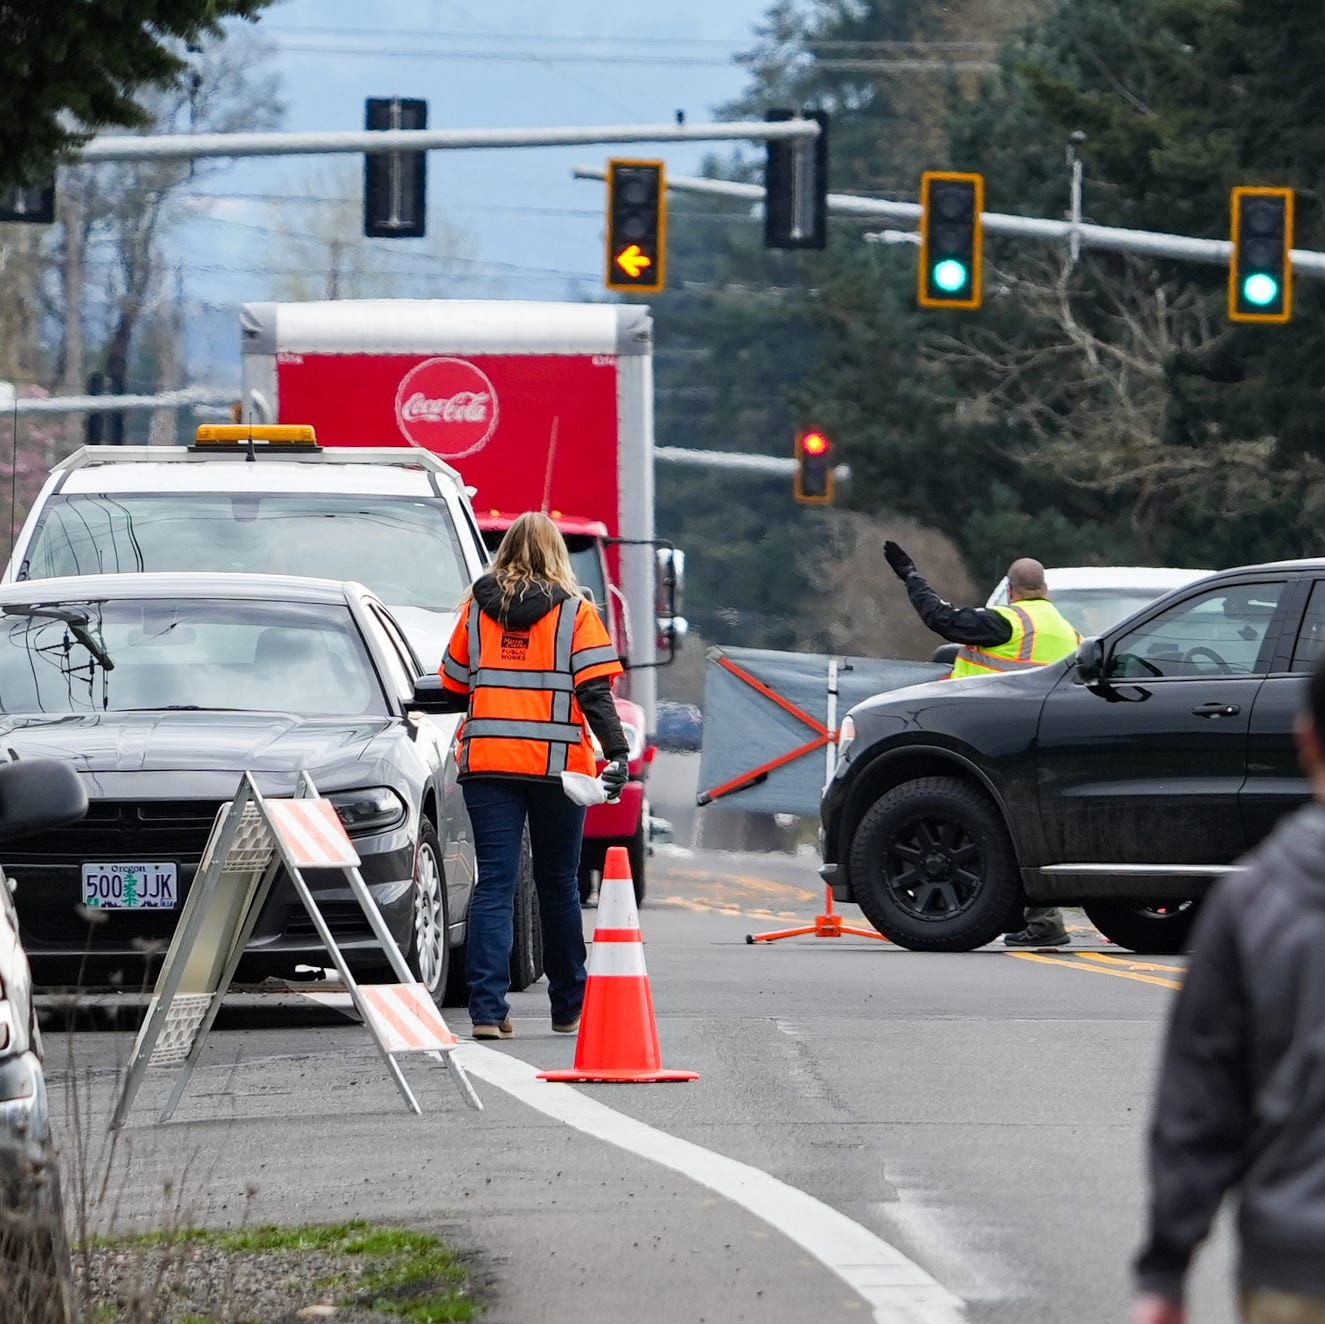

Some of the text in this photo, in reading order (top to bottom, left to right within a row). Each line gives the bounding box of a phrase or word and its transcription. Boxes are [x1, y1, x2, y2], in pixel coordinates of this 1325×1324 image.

[402, 391, 491, 422] Coca-Cola
[502, 648, 527, 656] PUBLIC
[111, 865, 146, 874] Oregon
[87, 874, 172, 898] 500 JJK
